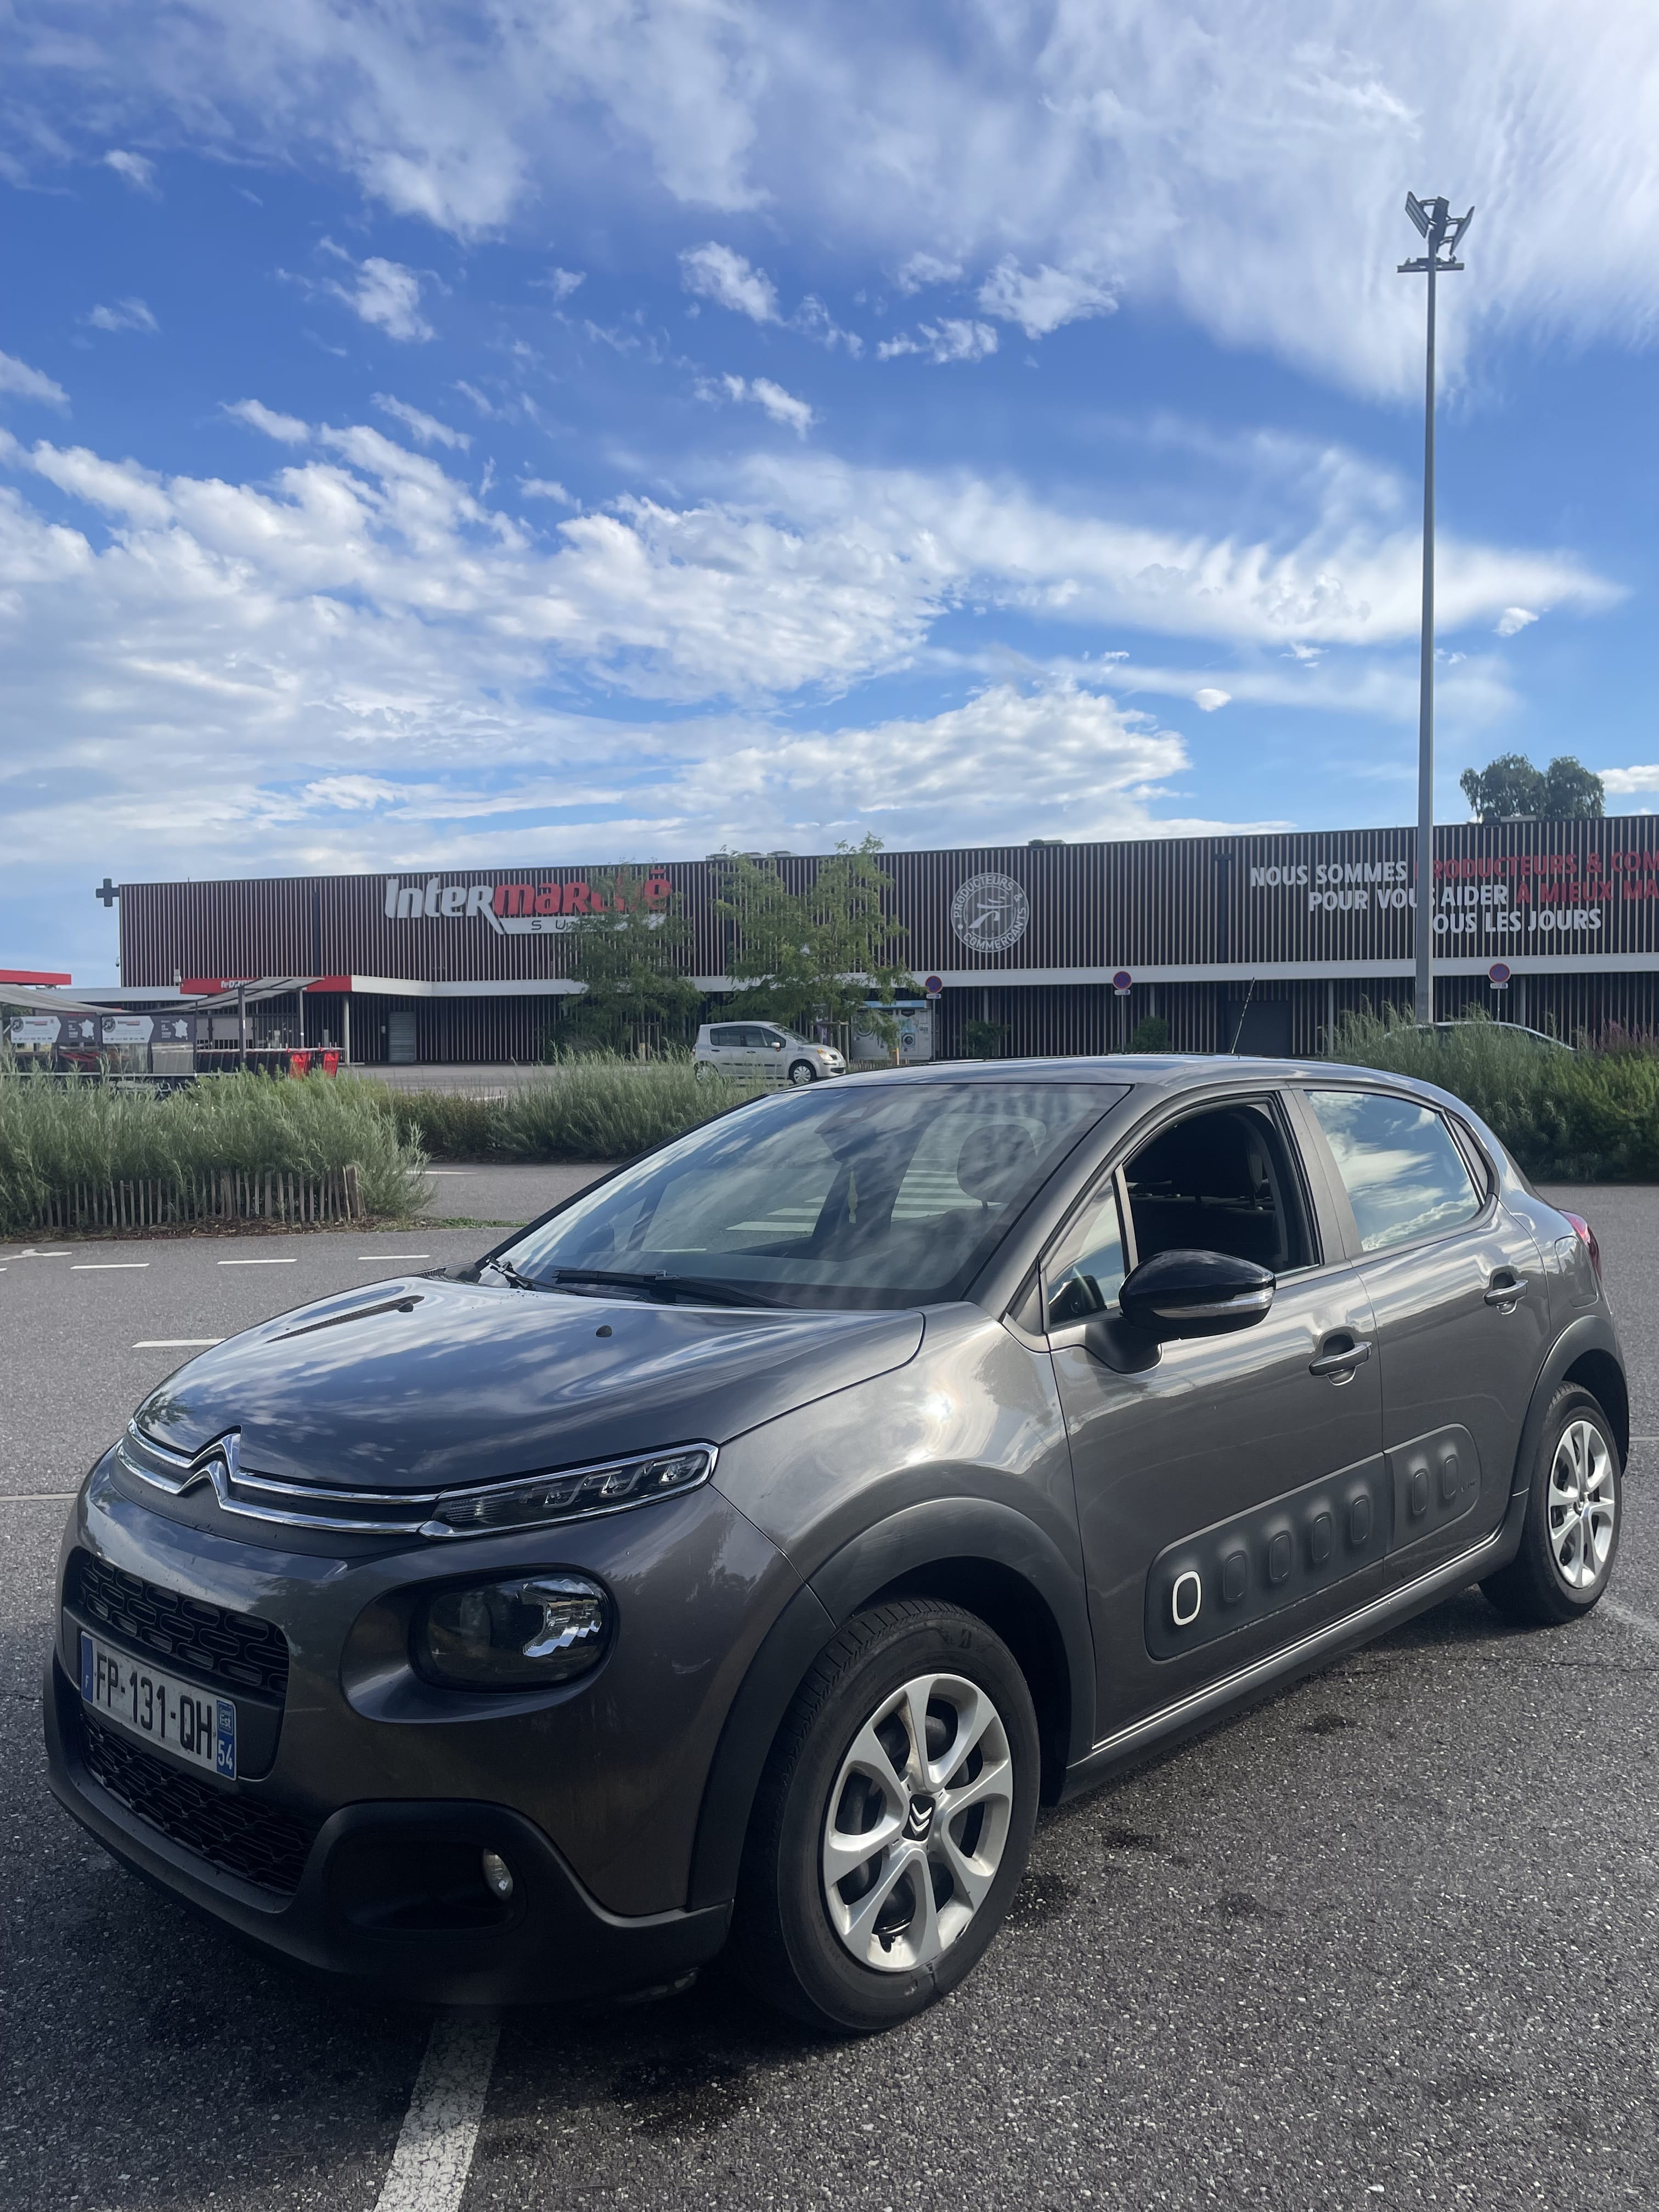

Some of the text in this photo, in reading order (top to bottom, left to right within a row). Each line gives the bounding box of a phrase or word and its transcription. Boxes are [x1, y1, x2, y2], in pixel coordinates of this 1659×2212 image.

[1251, 865, 1308, 887] NOUS
[1317, 861, 1407, 884] SOMMES
[1586, 853, 1602, 873] &
[1309, 890, 1368, 911] POUR
[1441, 884, 1508, 906] AIDER
[1516, 881, 1530, 904] À
[1540, 881, 1612, 903] MIEUX
[1624, 879, 1659, 900] MA
[954, 875, 1026, 950] PRODUCTEURS & COMMERÇANTS
[1433, 908, 1601, 934] OUS LES JOURS
[85, 1674, 89, 1689] F
[97, 1651, 212, 1760] FP-131-QH
[219, 1713, 231, 1729] Est
[218, 1739, 233, 1770] 54
